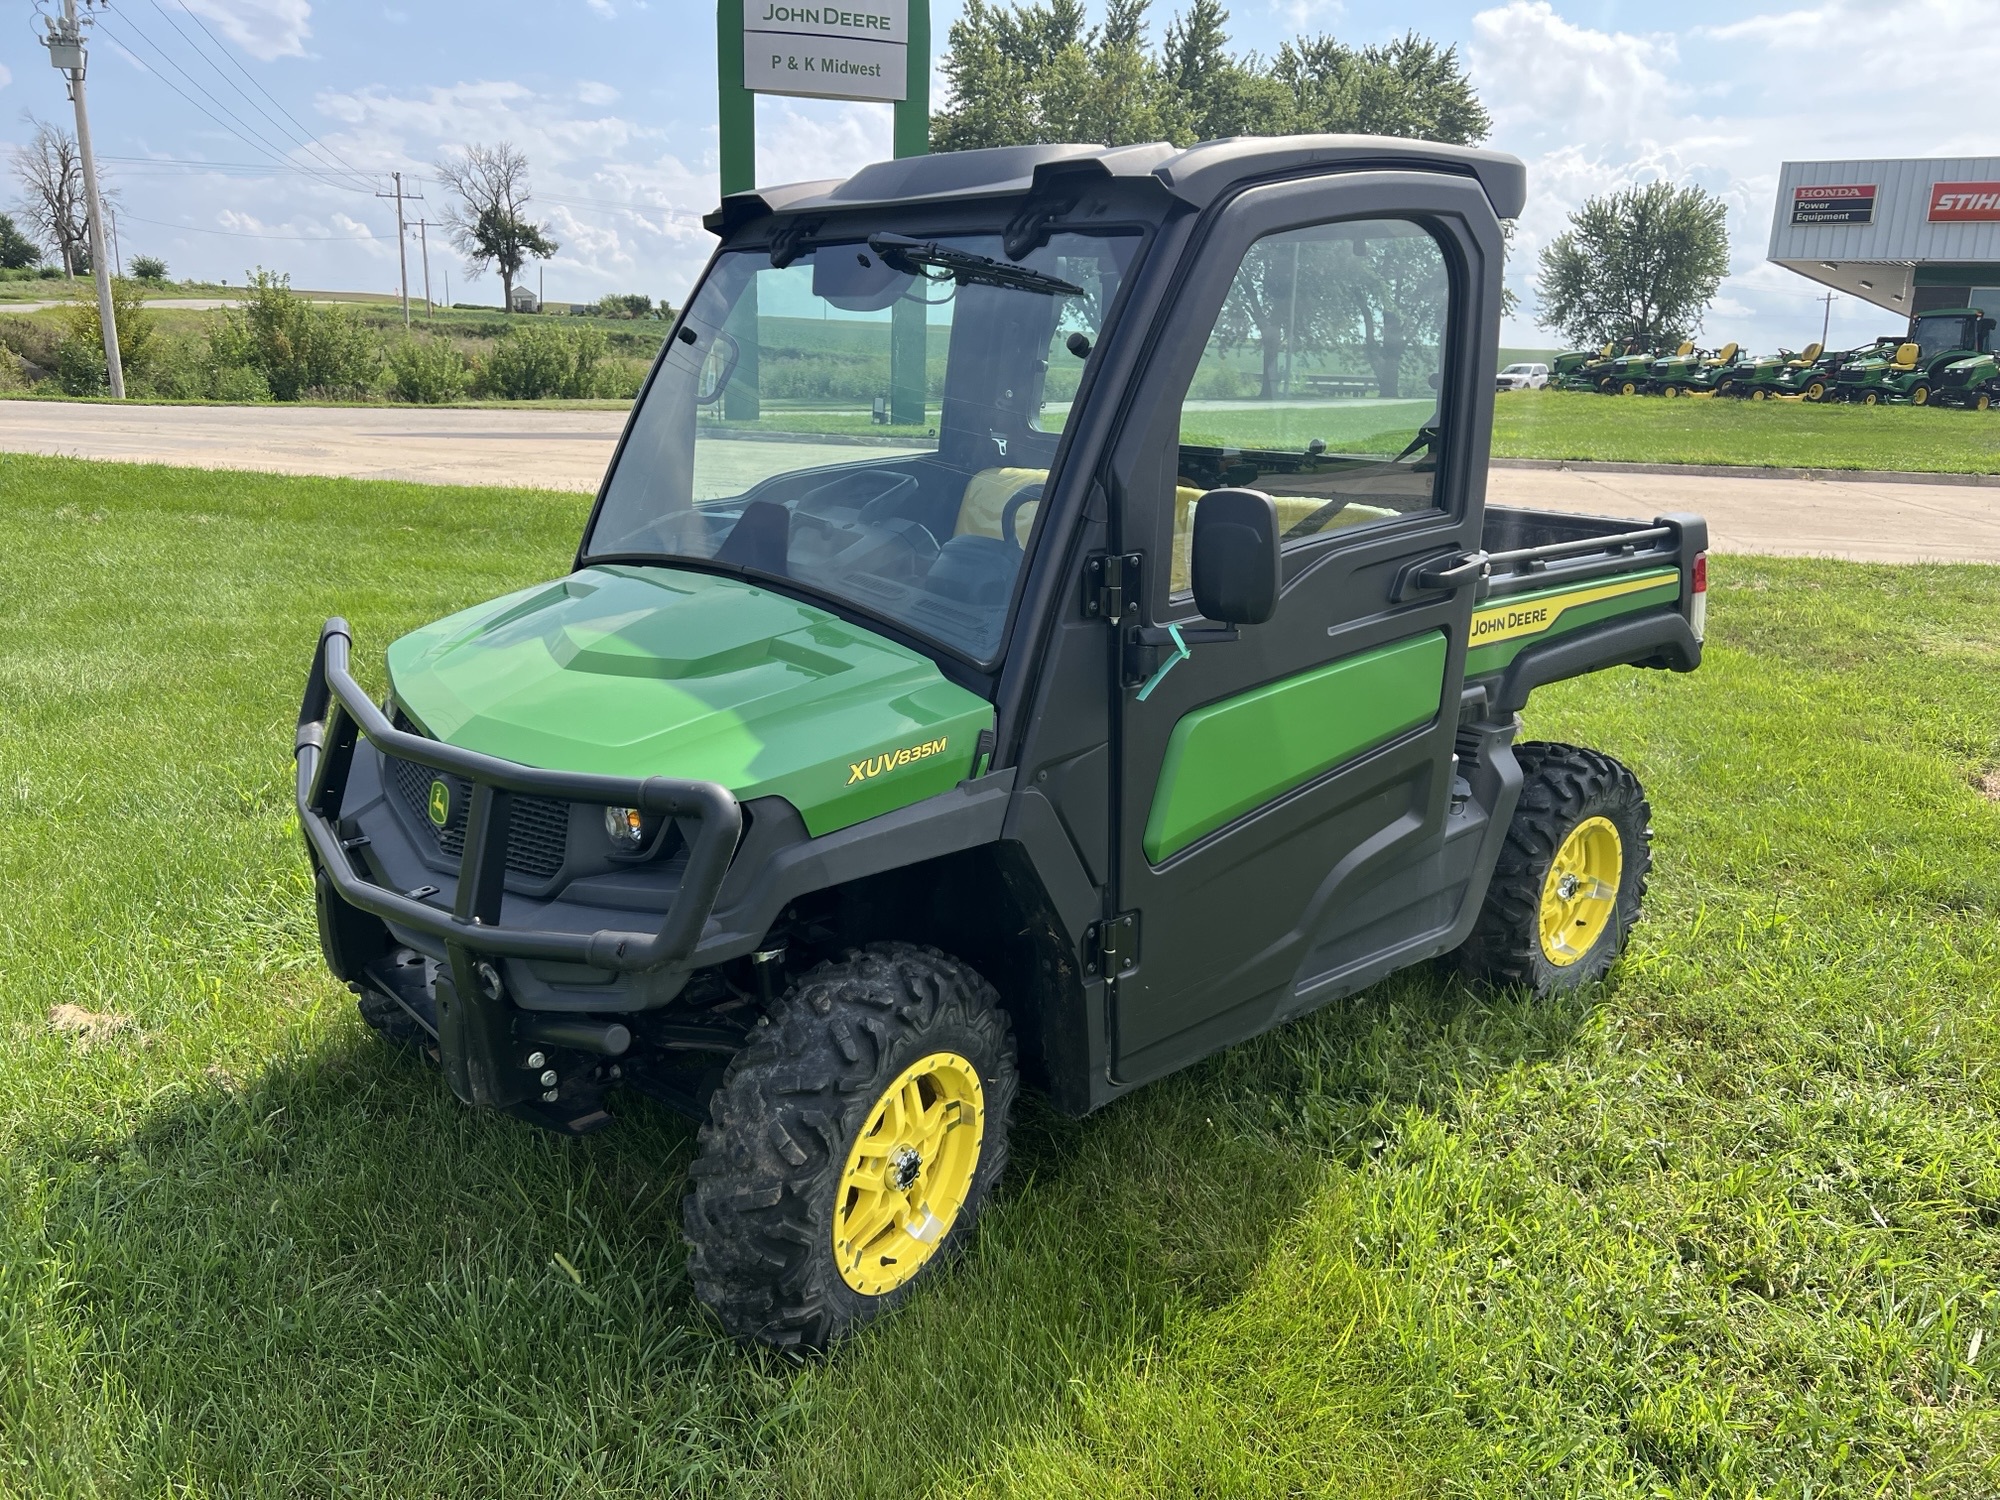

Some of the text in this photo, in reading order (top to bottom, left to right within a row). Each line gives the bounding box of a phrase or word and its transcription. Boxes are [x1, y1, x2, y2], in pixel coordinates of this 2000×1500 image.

[762, 3, 891, 31] JOHN DEERE
[771, 55, 881, 78] P & K Midwest
[1799, 187, 1862, 199] HONDA
[1796, 212, 1850, 222] Equipment
[1798, 201, 1830, 210] Power
[1471, 607, 1548, 637] JOHN DEERE
[845, 736, 949, 787] XUV835M
